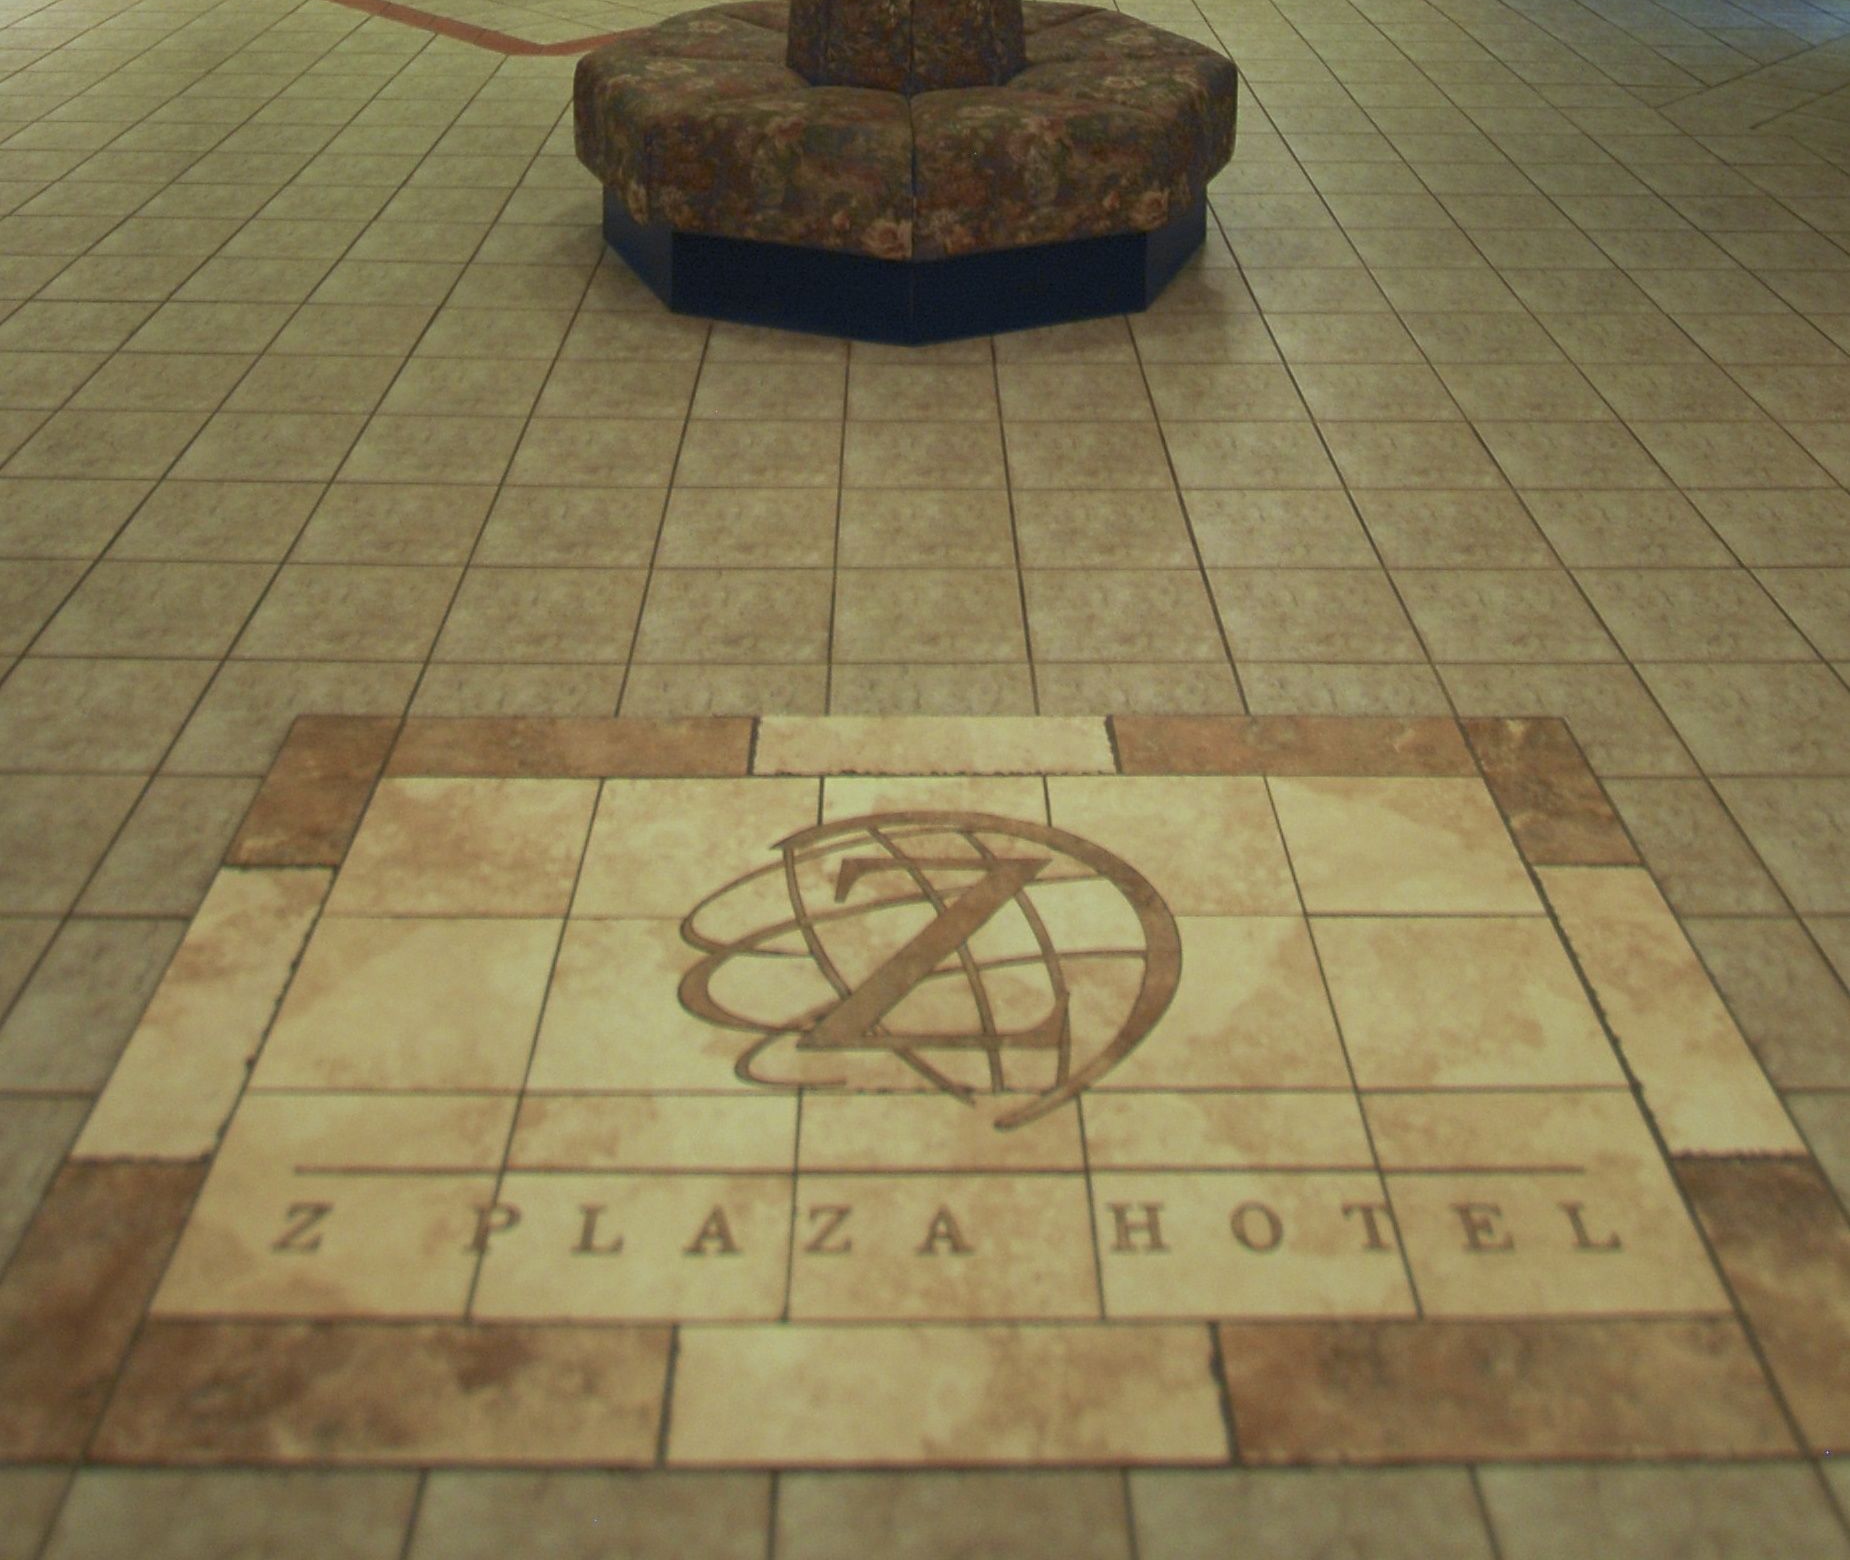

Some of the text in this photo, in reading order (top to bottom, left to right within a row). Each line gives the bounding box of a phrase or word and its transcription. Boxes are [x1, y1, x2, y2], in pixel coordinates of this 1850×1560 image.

[272, 1200, 1624, 1257] Z PLAZA HOTEL
